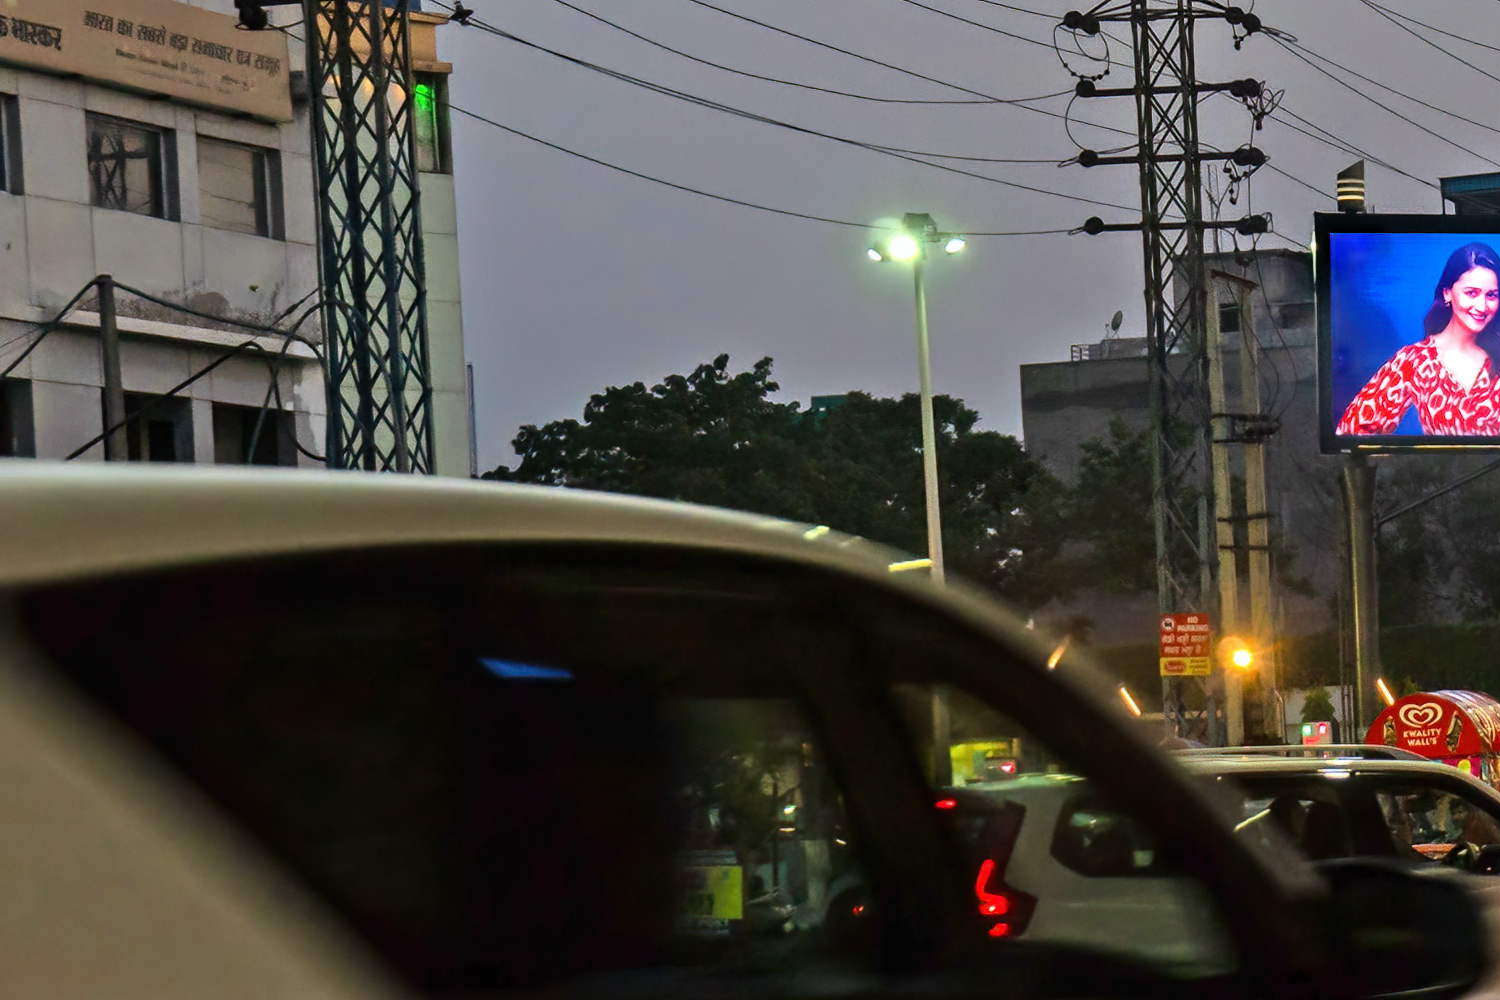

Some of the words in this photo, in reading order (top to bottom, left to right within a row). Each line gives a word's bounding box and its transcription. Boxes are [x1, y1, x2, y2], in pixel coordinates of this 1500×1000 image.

[84, 10, 114, 33] भारत
[117, 19, 134, 38] का
[137, 24, 167, 46] सबसे
[1187, 616, 1198, 624] NO
[1177, 624, 1208, 632] PARKING
[1403, 728, 1442, 739] KWALITY
[1407, 736, 1438, 747] WALL'S
